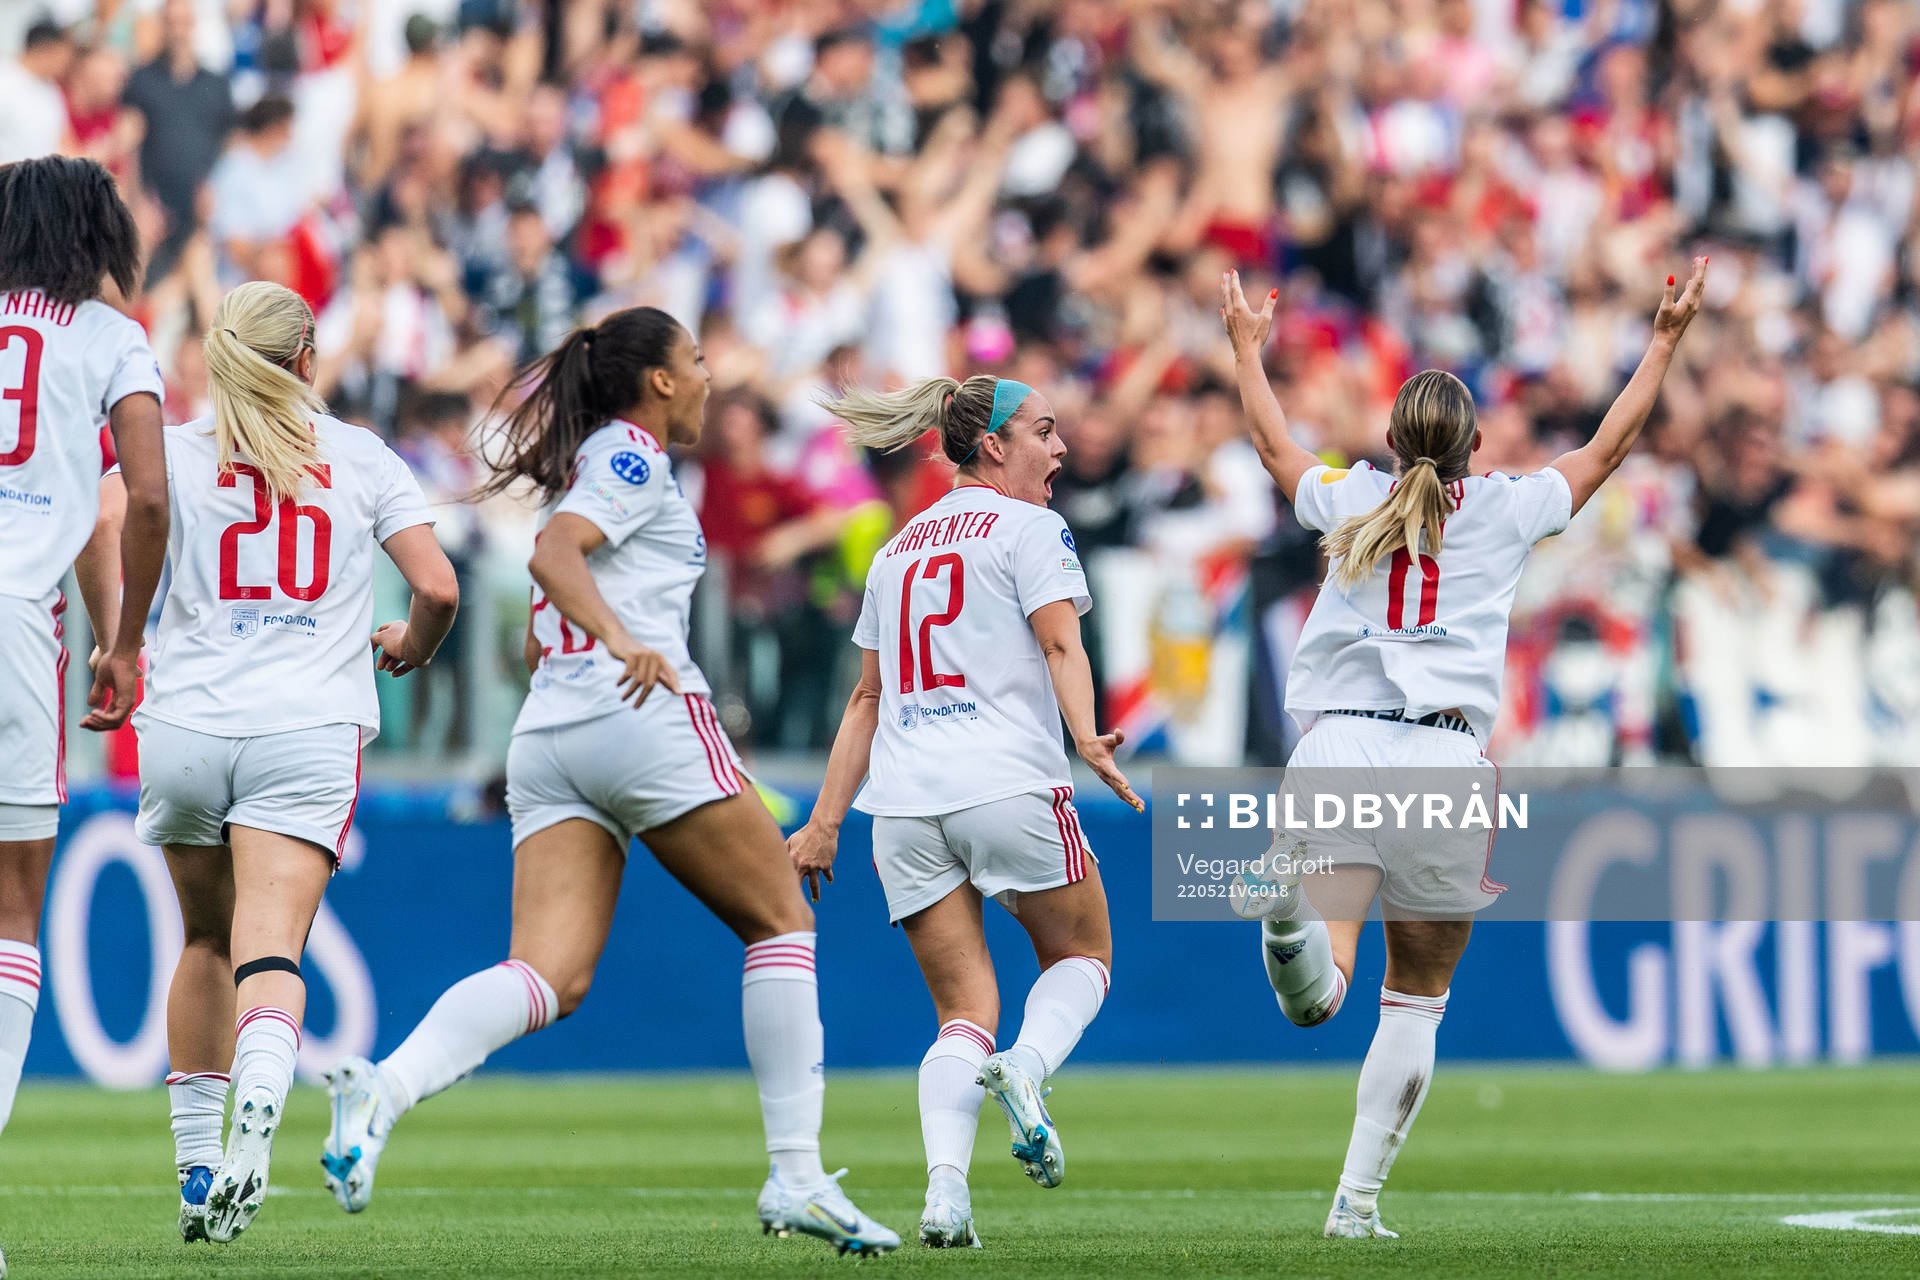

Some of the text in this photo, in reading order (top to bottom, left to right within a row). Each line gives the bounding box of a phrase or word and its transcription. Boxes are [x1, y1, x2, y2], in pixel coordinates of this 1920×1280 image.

[0, 290, 77, 327] NARD
[217, 462, 333, 602] 26
[886, 511, 1000, 558] CARPENTER
[899, 552, 966, 695] 12
[1387, 625, 1447, 636] ONDATION
[920, 701, 977, 719] FONDATION
[1545, 807, 1920, 1073] GRIF
